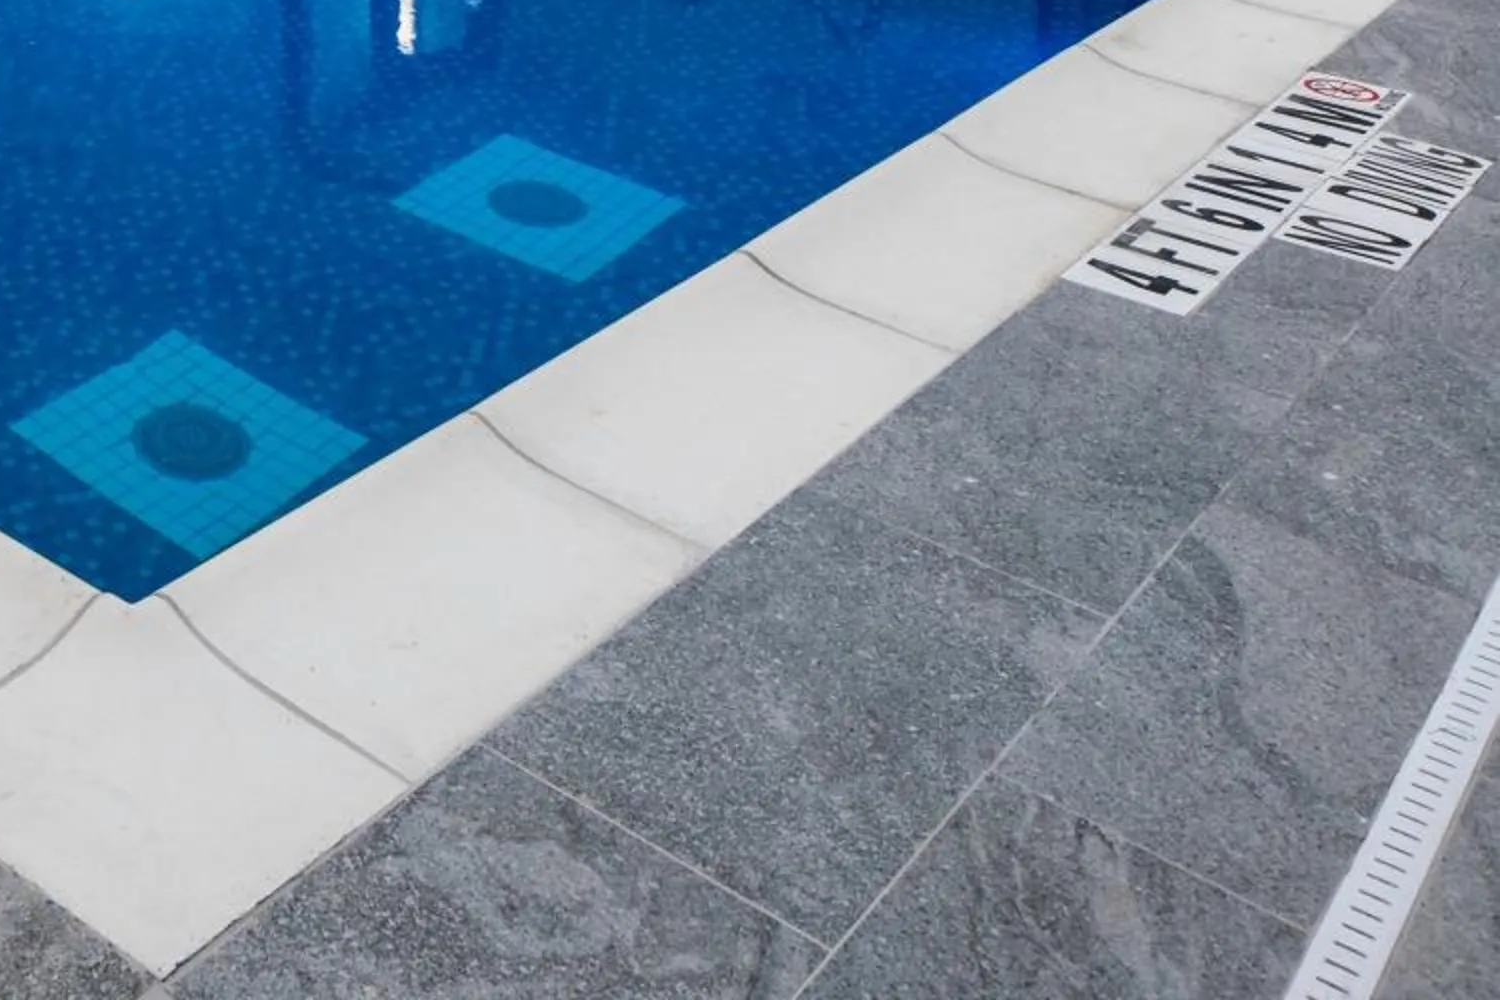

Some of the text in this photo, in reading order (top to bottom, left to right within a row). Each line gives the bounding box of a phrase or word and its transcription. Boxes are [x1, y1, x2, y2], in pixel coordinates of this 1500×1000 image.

[1272, 93, 1384, 135] M
[1253, 121, 1353, 149] 4
[1226, 145, 1325, 174] 1
[1184, 163, 1304, 212] IN
[1282, 136, 1484, 265] NO DIVING
[1161, 198, 1266, 231] 6
[1109, 217, 1240, 277] FT
[1087, 258, 1200, 296] 4
